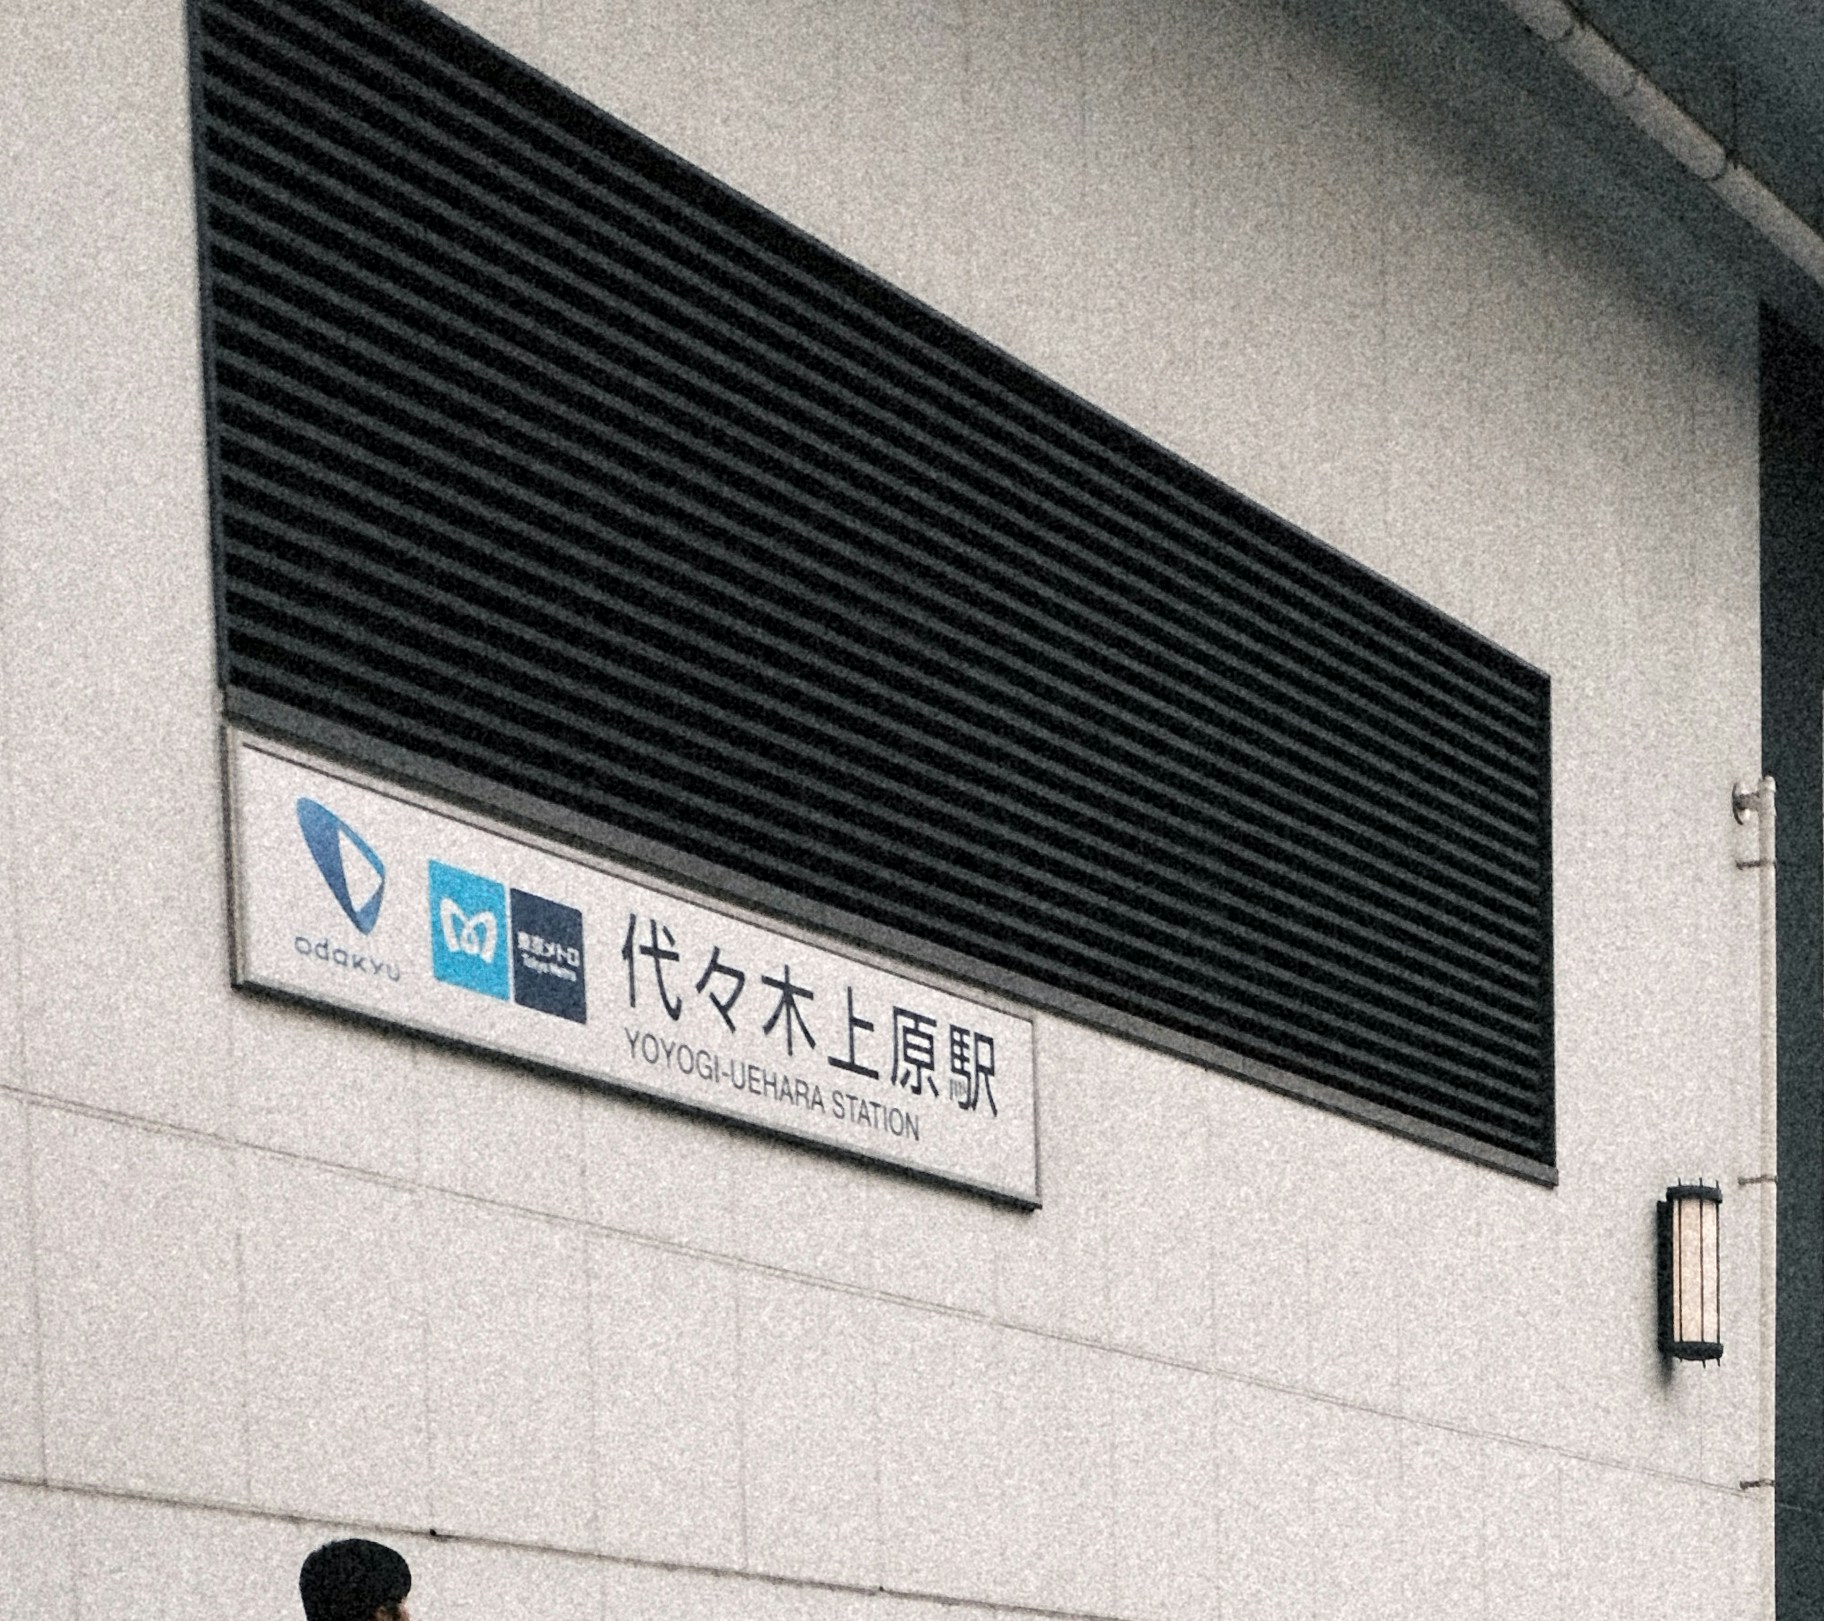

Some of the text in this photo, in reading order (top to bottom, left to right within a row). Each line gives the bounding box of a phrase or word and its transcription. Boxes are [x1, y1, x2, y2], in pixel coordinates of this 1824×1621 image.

[621, 912, 998, 1118] 代々木上原駅
[624, 1027, 921, 1142] YOYOGI-UEHARA STATION
